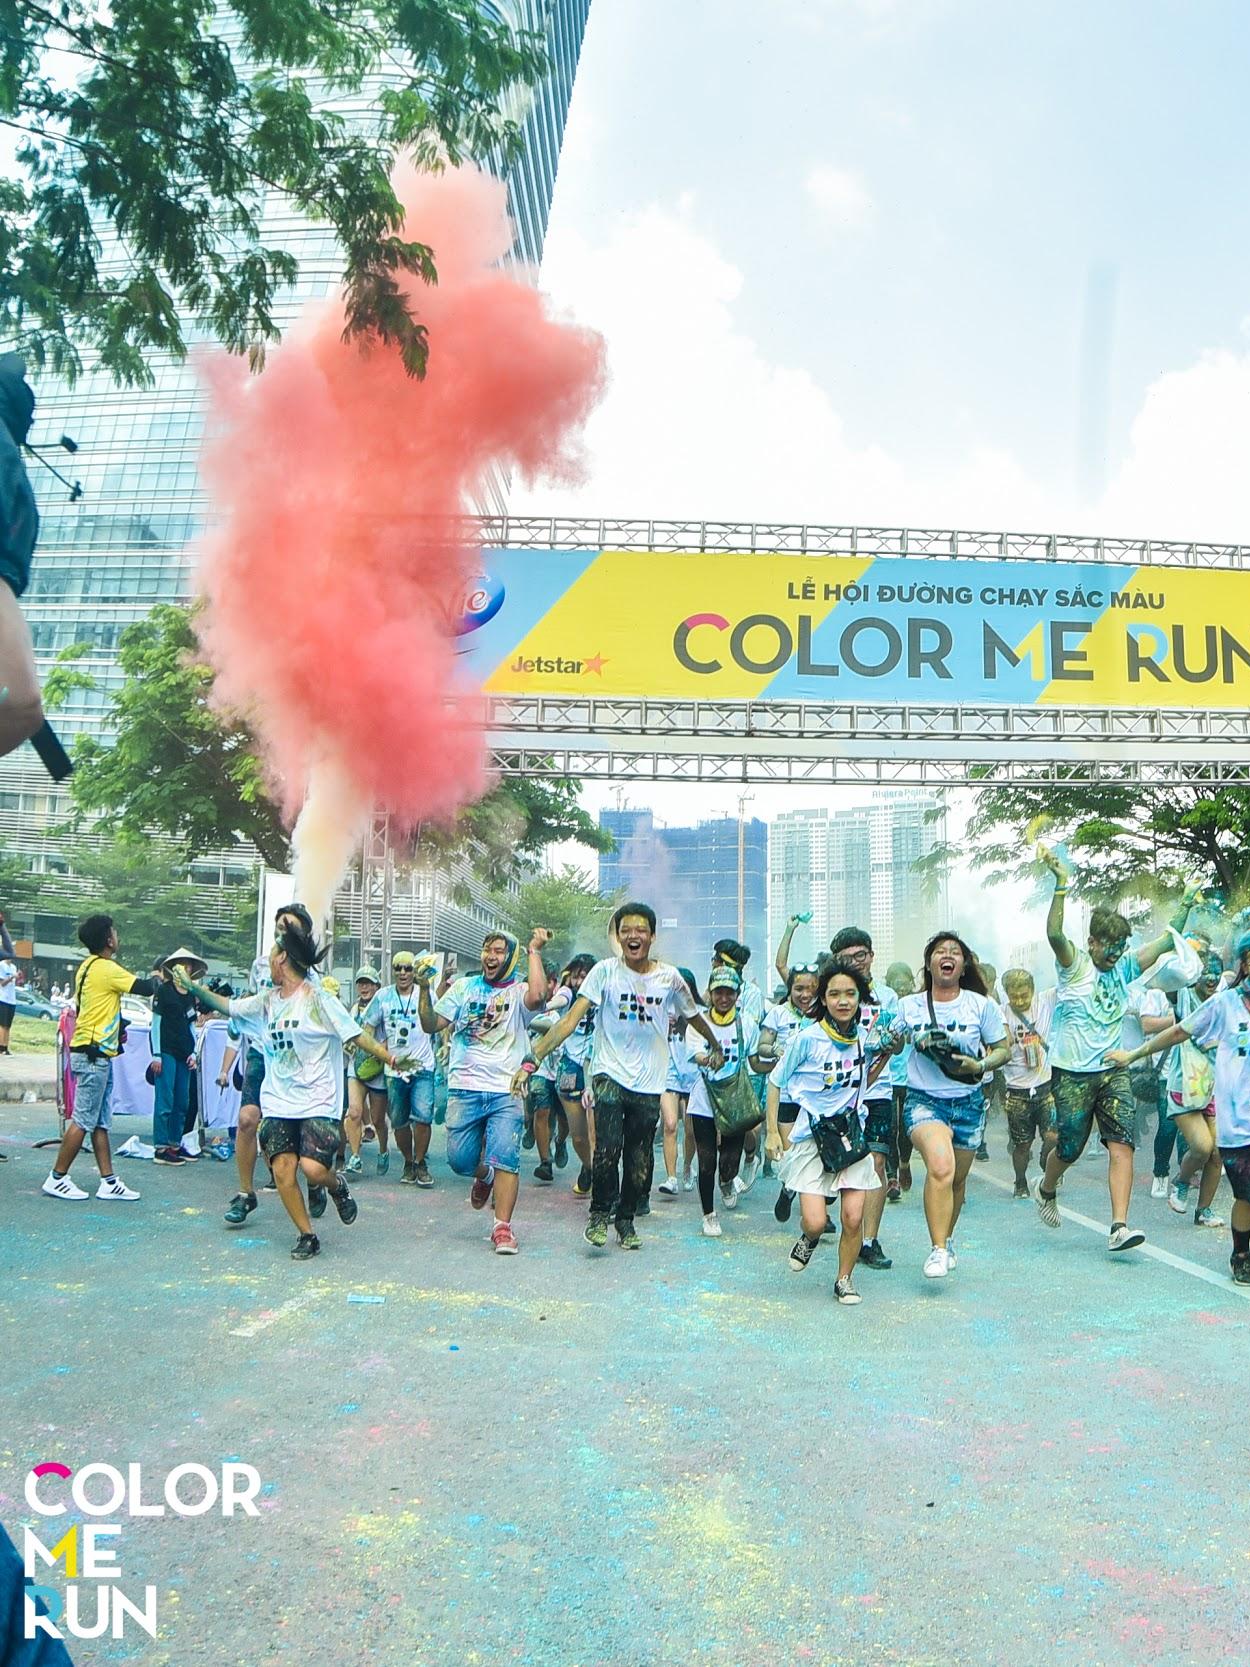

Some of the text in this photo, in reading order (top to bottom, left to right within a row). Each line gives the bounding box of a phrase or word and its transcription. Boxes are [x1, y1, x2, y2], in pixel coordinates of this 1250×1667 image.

[788, 576, 1165, 609] LỄ HỘI ĐƯỜNG CHẠY SẮC MÀU
[673, 612, 954, 680] COLOR
[983, 618, 1094, 682] ME
[511, 655, 583, 674] Jetstar
